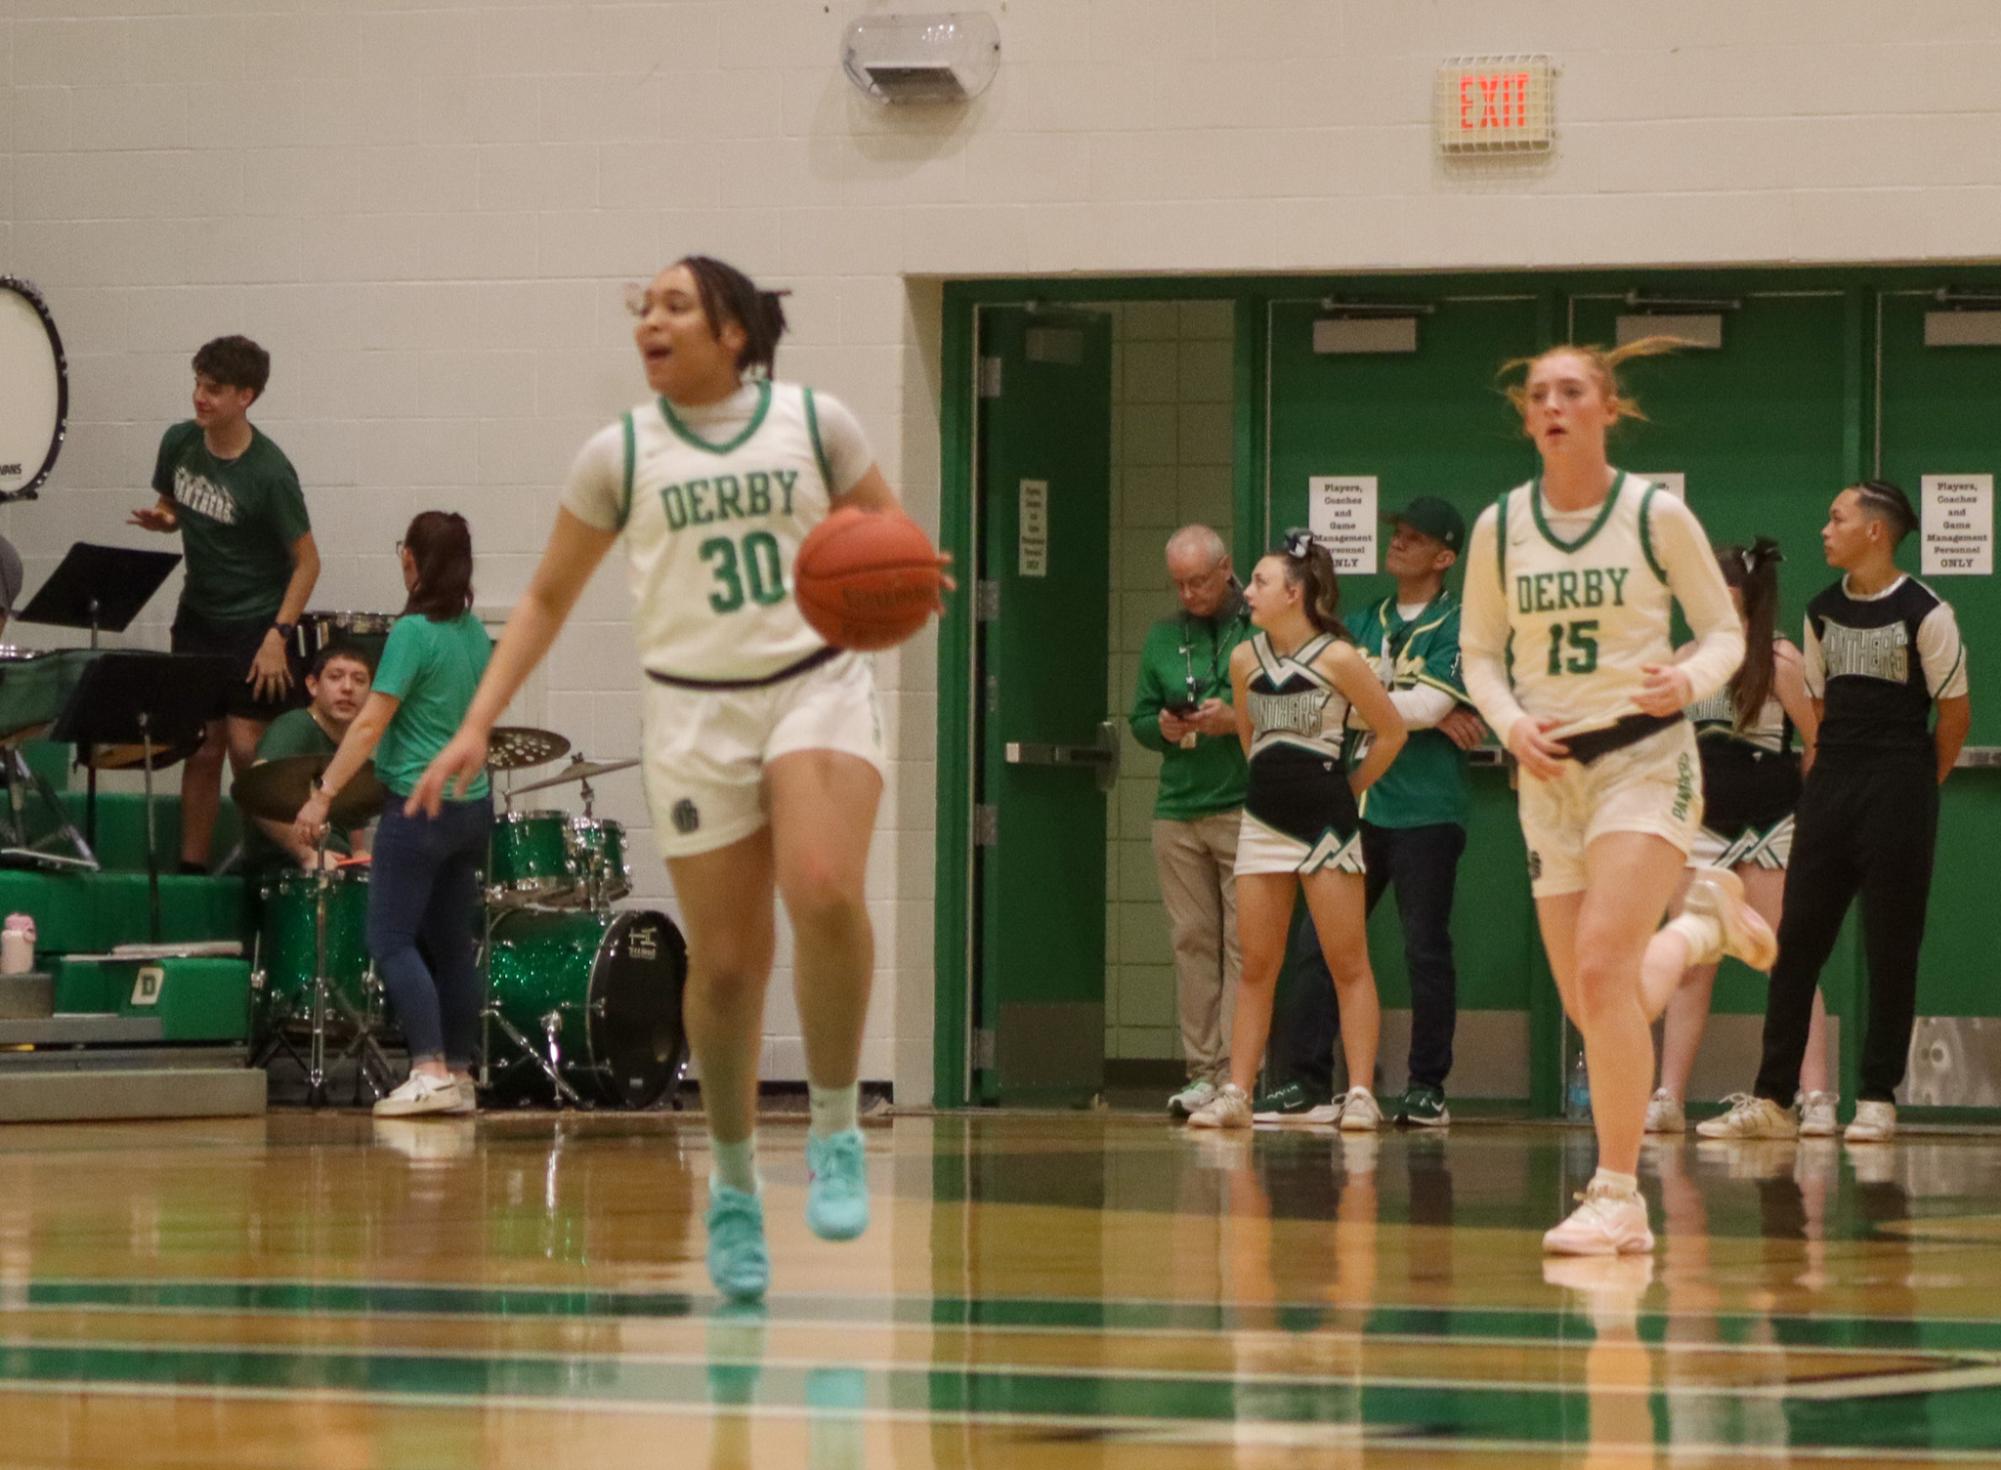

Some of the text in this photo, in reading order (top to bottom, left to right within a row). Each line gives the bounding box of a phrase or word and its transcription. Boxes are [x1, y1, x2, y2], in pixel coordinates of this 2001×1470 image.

[1460, 73, 1529, 128] EXIT
[1324, 483, 1363, 493] Players,
[1937, 482, 1978, 493] Players,
[660, 470, 798, 532] DERBY
[1324, 496, 1362, 505] Coaches
[1937, 495, 1977, 504] Coaches
[1334, 509, 1352, 518] and
[1948, 508, 1966, 517] and
[1329, 522, 1356, 530] Game
[1943, 521, 1971, 529] Game
[1314, 534, 1372, 543] Management
[1927, 534, 1987, 543] Management
[1331, 546, 1365, 554] rsonnel
[1934, 546, 1980, 554] Personnel
[1335, 559, 1359, 568] NLY
[1940, 558, 1974, 568] ONLY
[700, 531, 787, 614] 30
[1516, 567, 1630, 614] DERBY
[1547, 619, 1599, 676] 15
[142, 974, 156, 996] D
